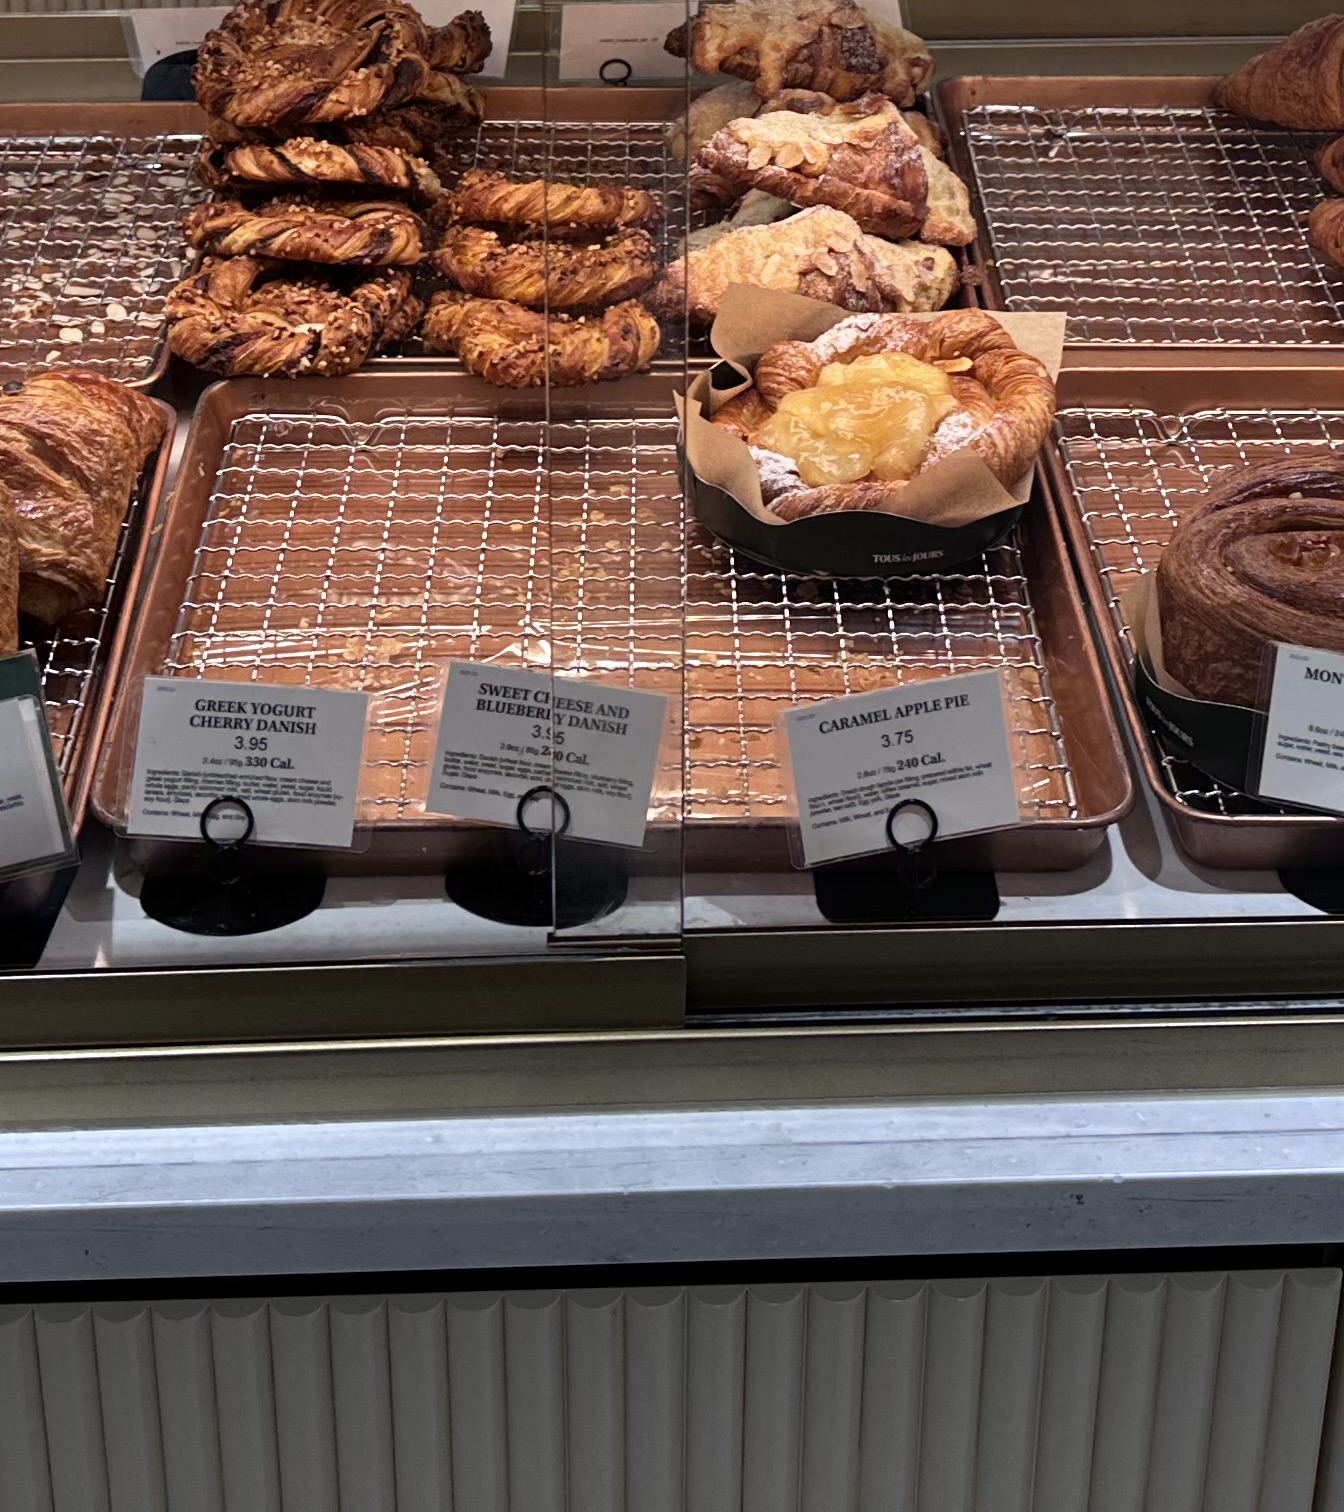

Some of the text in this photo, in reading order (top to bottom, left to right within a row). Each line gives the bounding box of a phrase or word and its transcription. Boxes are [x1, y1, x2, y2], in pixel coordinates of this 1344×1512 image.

[872, 554, 901, 563] TOUS
[195, 699, 316, 719] GREEK YOGURT
[479, 682, 532, 701] SWEET
[596, 703, 630, 719] AND
[568, 712, 628, 736] DANISH
[819, 694, 971, 734] CARAMEL APPLE PIE
[190, 714, 317, 735] CHERRY DANISH
[234, 736, 268, 751] 3.95
[880, 730, 914, 748] 3.75
[245, 756, 268, 768] 330
[270, 757, 295, 769] Cal.
[541, 745, 563, 762] 20
[566, 752, 590, 766] Cal.
[896, 757, 919, 772] 240
[921, 752, 945, 766] Cal.
